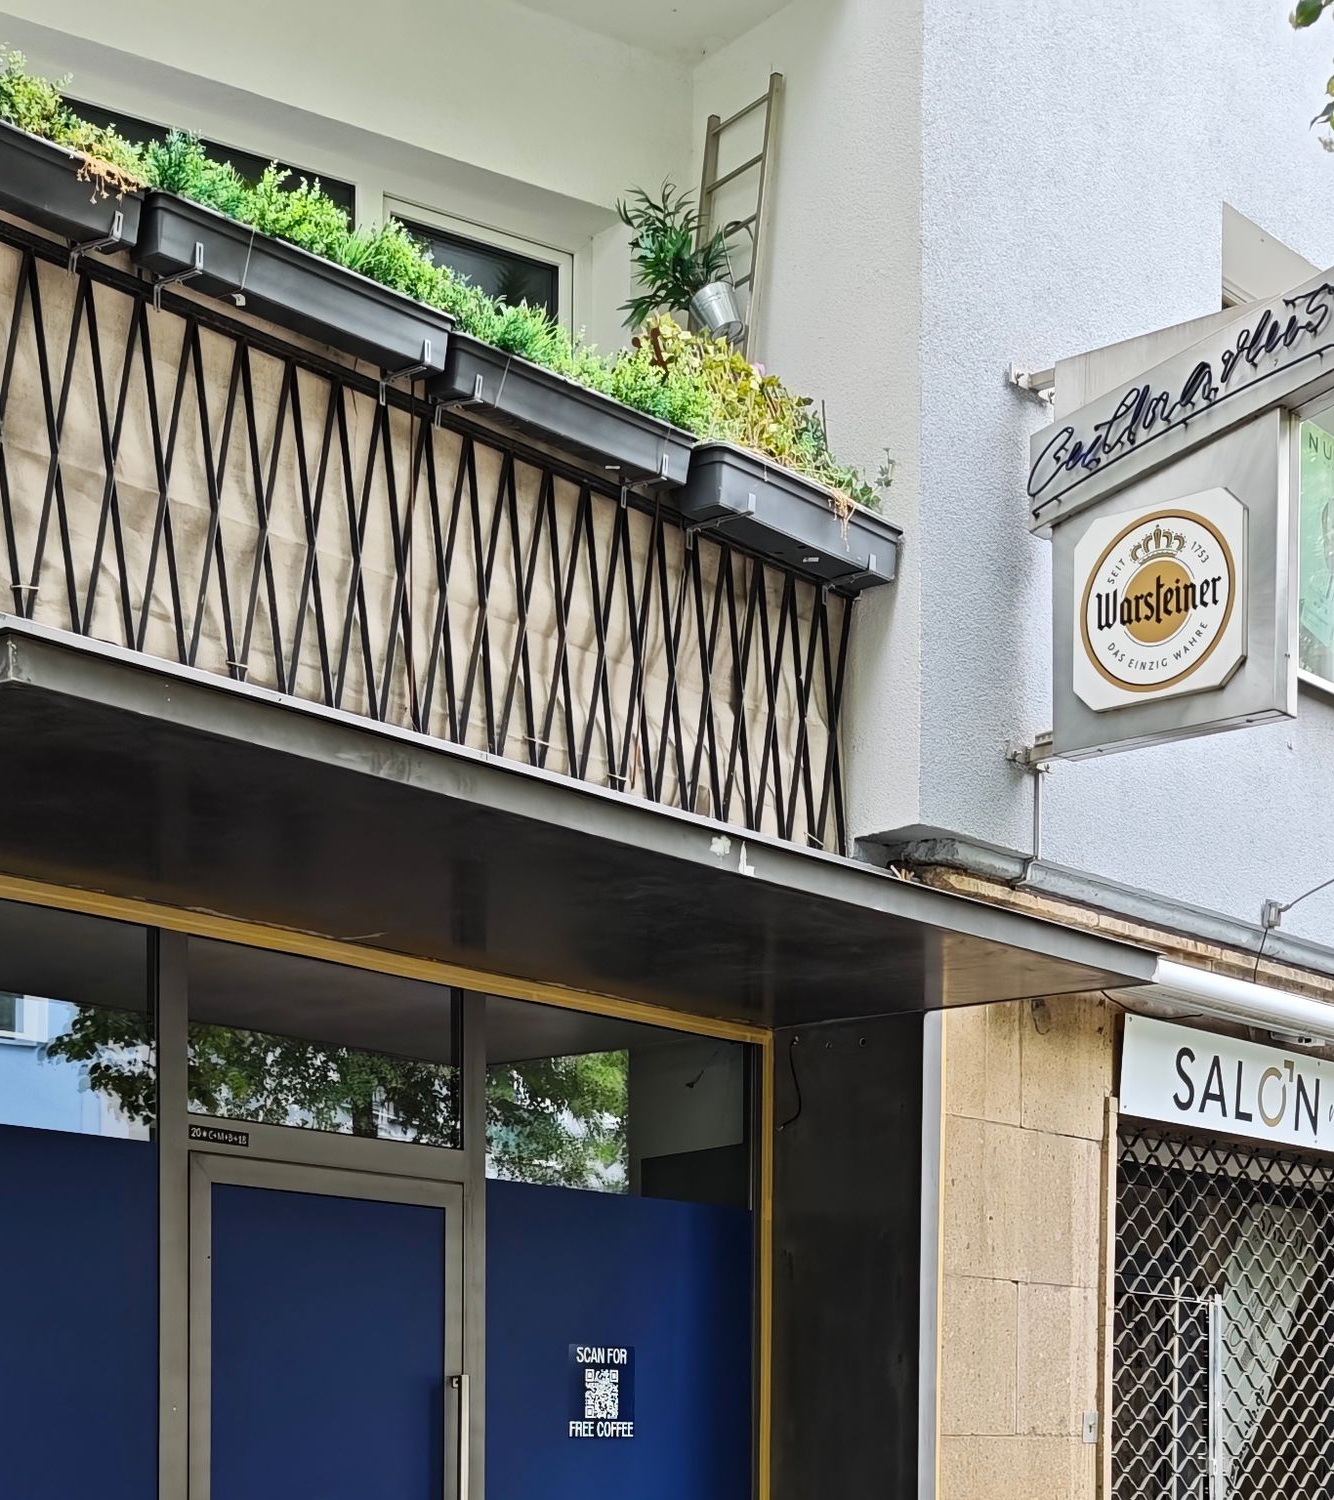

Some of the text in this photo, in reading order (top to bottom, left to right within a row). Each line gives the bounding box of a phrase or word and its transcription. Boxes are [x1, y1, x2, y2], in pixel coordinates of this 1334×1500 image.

[1107, 541, 1210, 585] SEIT 1753
[1095, 574, 1222, 631] Warsteiner
[1107, 622, 1208, 671] DAS EINZIG WAHRE
[1173, 1047, 1320, 1136] SALON
[576, 1347, 627, 1364] SCAN FOR
[569, 1421, 634, 1437] FREE COFFEE
